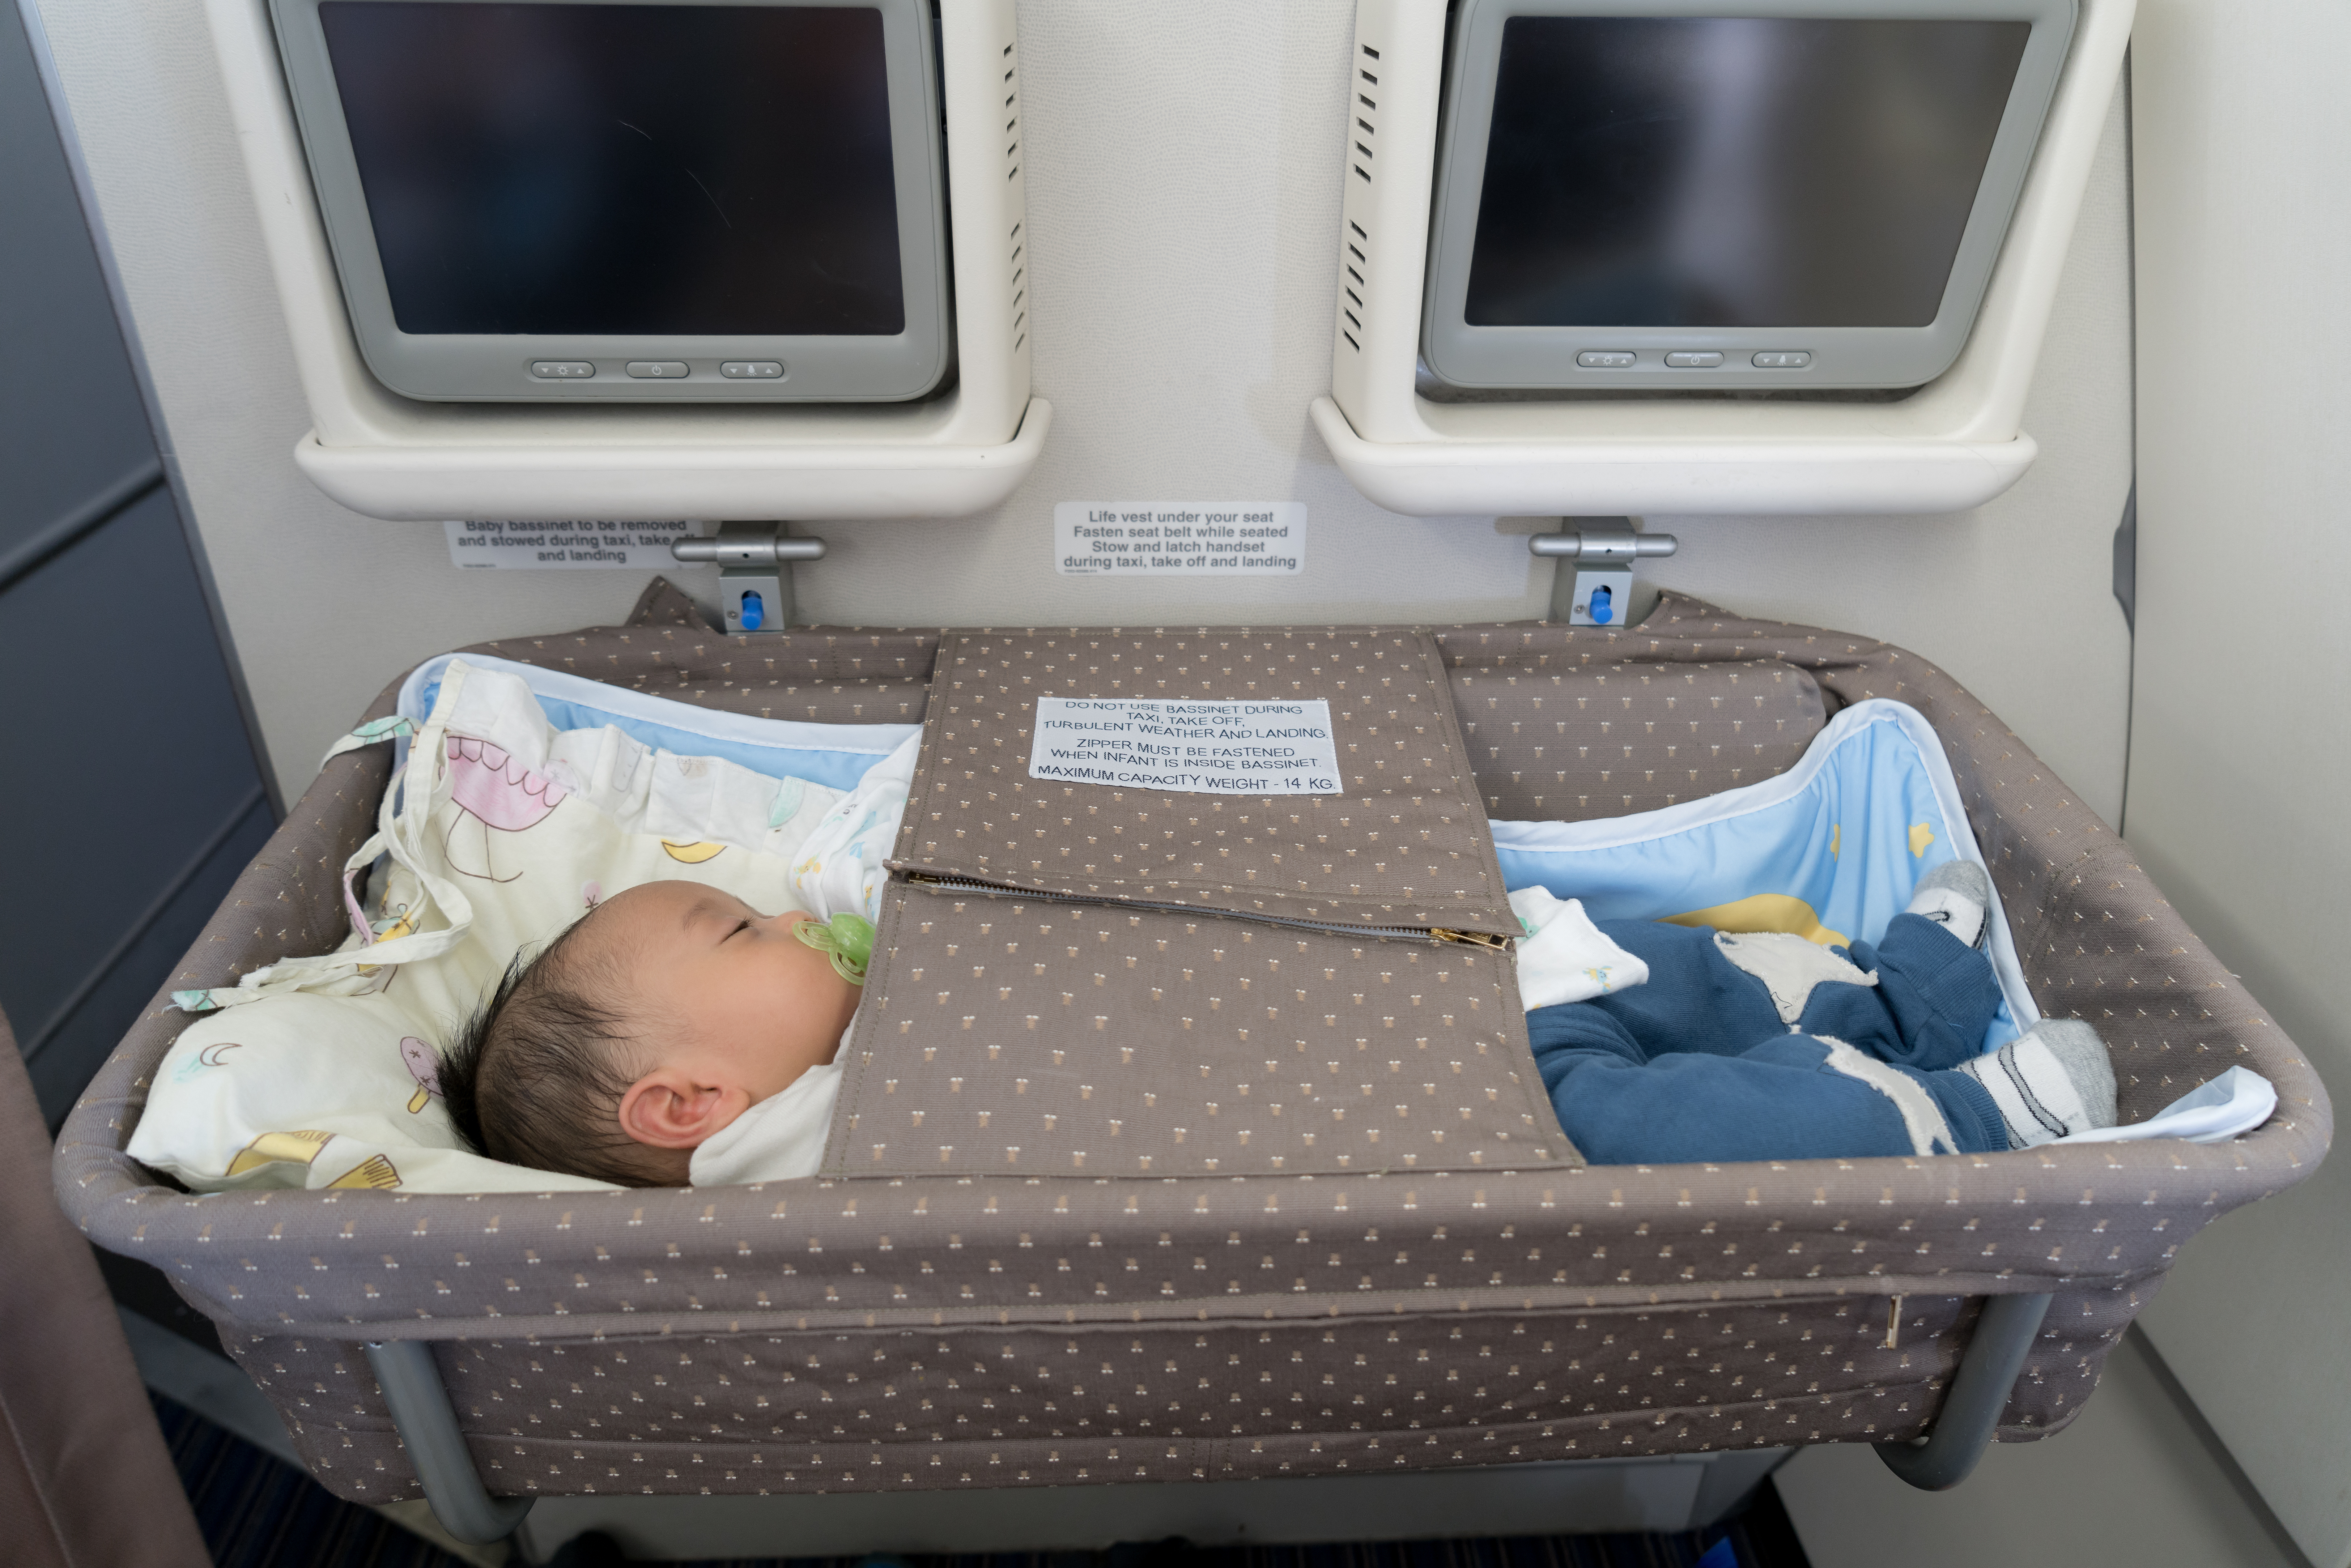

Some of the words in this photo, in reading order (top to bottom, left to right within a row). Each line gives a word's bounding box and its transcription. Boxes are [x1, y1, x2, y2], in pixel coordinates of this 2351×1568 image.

[1090, 511, 1116, 522] Life
[1122, 512, 1152, 522] vest
[1158, 511, 1200, 522] under
[1205, 513, 1238, 525] your
[1243, 512, 1274, 522] seat
[465, 521, 503, 534] Baby
[509, 521, 573, 531] bassinet
[578, 521, 593, 531] to
[598, 521, 616, 530] be
[621, 521, 686, 531] removed
[1074, 526, 1123, 537] Fasten
[1129, 527, 1159, 537] seat
[1165, 527, 1191, 537] belt
[1196, 527, 1234, 537] while
[1240, 527, 1288, 537] seated
[459, 534, 486, 546] and
[491, 534, 545, 546] stowed
[549, 534, 599, 549] during
[603, 534, 635, 547] taxi,
[639, 534, 671, 545] take
[1093, 541, 1128, 552] Stow
[1134, 541, 1160, 552] and
[1166, 541, 1200, 552] latch
[1207, 541, 1264, 552] handset
[538, 550, 565, 561] and
[570, 549, 626, 563] landing
[1064, 556, 1111, 570] during
[1117, 556, 1146, 568] taxi,
[1151, 556, 1181, 567] take
[1187, 556, 1206, 567] off
[1211, 556, 1237, 567] and
[1243, 556, 1296, 570] landing
[1167, 706, 1239, 714] BASSINET
[1127, 713, 1163, 724] TAXI,
[1212, 717, 1244, 727] OFF,
[1044, 721, 1133, 730] TURBULENT
[1139, 725, 1215, 738] WEATHER
[1219, 729, 1251, 739] AND
[1256, 728, 1328, 738] LANDING.
[1077, 739, 1132, 750] ZIPPER
[1138, 743, 1180, 755] MUST
[1187, 747, 1207, 756] BE
[1213, 747, 1294, 757] FASTENED
[1051, 749, 1097, 759] WHEN
[1104, 752, 1158, 766] INFANT
[1185, 759, 1235, 770] INSIDE
[1242, 759, 1321, 768] BASSINET.
[1038, 766, 1113, 780] MAXIMUM
[1118, 773, 1200, 785] CAPACITY
[1206, 776, 1268, 789] WEIGHT
[1284, 778, 1301, 788] 14
[1310, 779, 1335, 789] KG.
